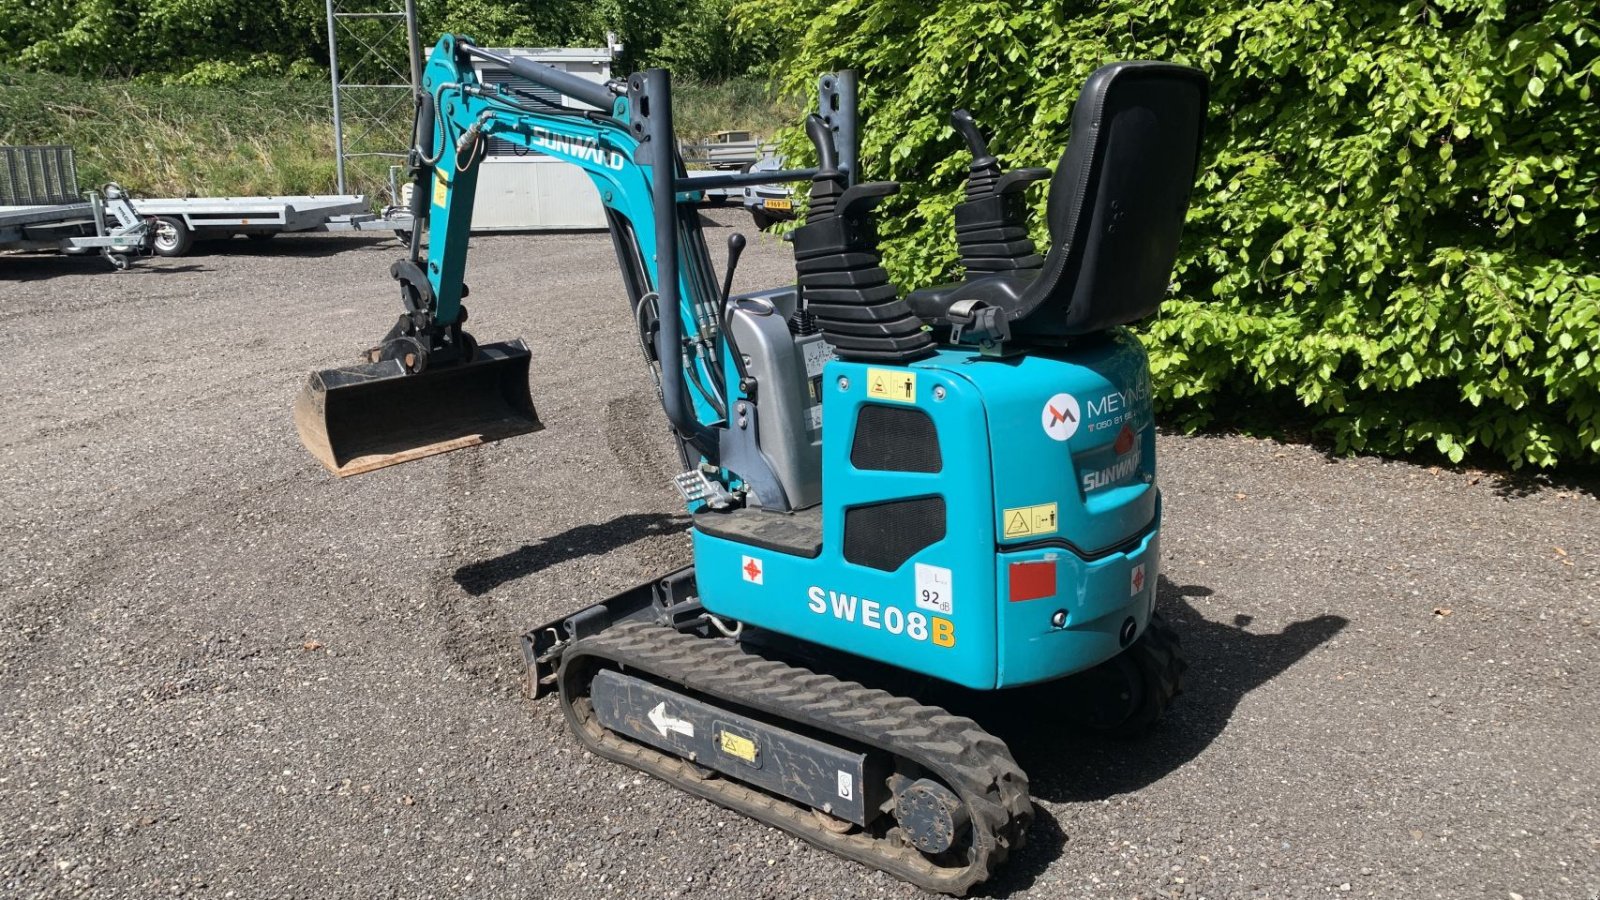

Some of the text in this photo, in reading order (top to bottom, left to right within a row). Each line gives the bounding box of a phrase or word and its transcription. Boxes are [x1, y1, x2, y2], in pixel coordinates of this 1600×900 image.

[532, 126, 624, 171] SUNWARD
[1096, 419, 1112, 430] 050
[808, 585, 956, 648] SWE08B
[922, 589, 951, 612] 92 dB
